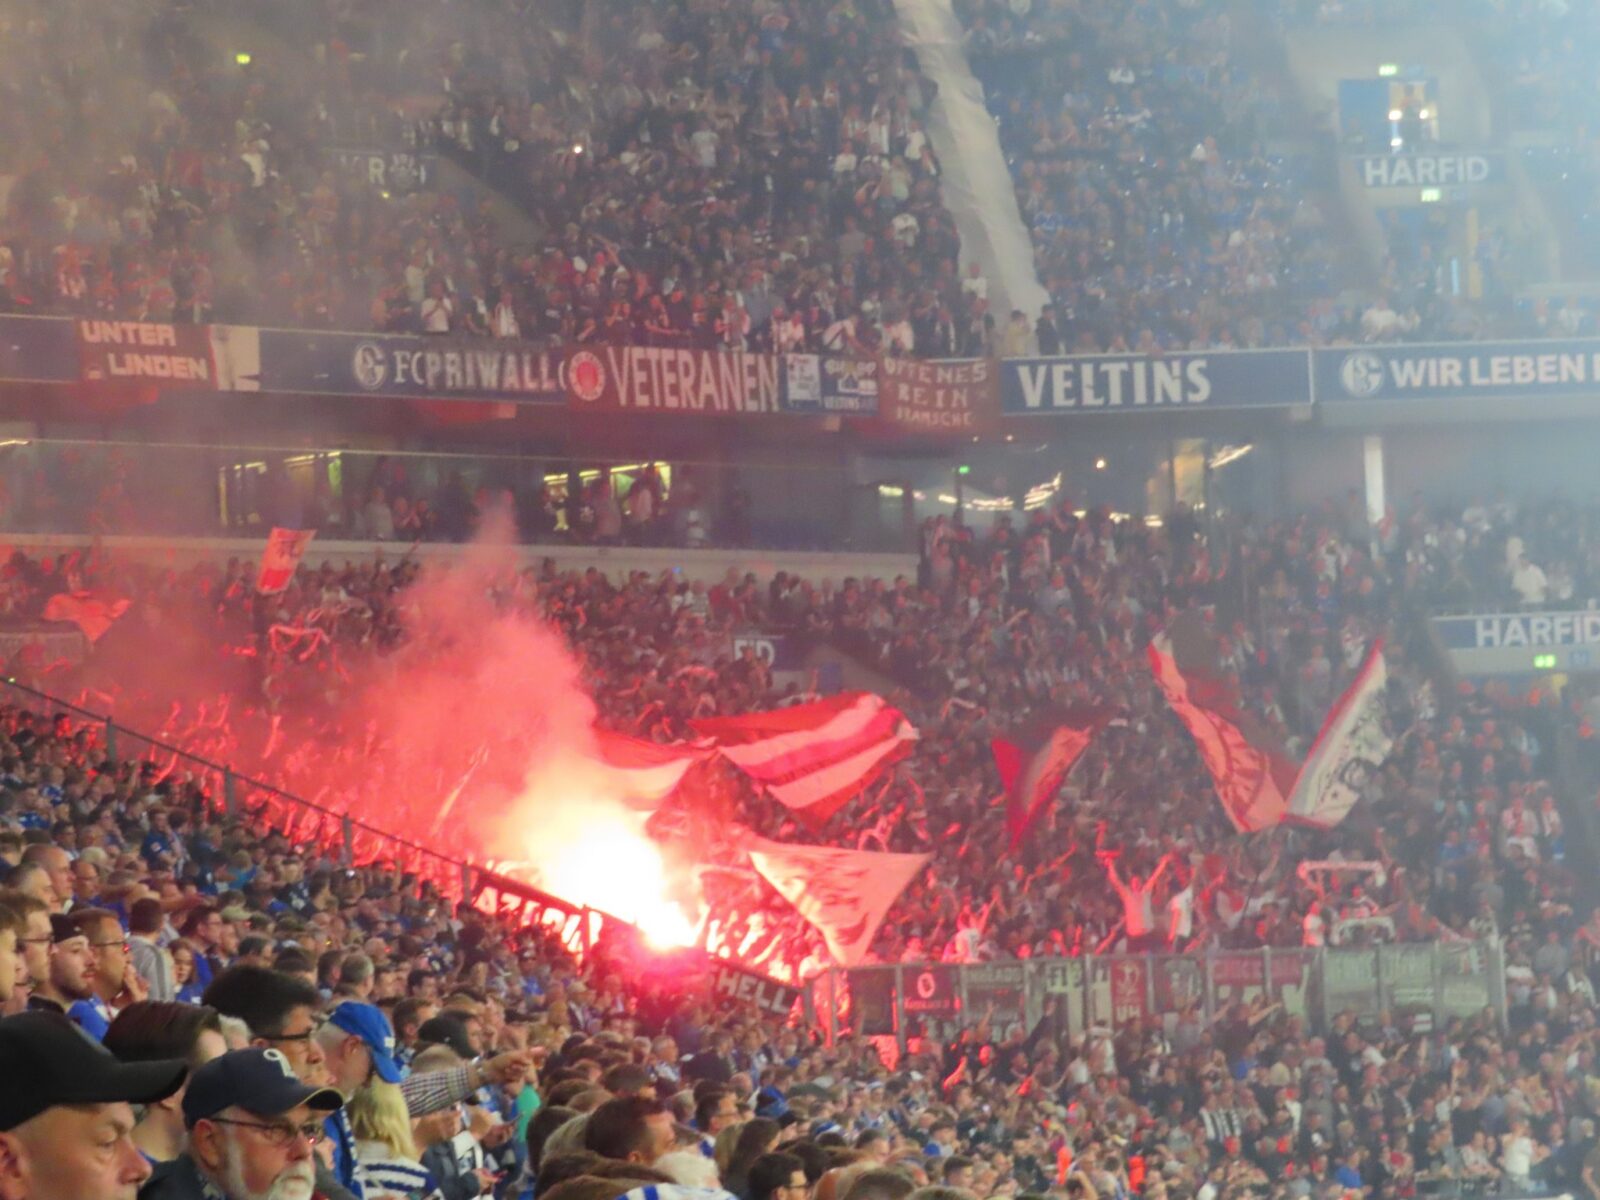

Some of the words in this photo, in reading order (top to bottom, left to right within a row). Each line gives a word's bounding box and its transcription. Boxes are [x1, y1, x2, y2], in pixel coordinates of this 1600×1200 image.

[1364, 156, 1490, 186] HARFID
[81, 320, 176, 346] UNTER
[107, 352, 208, 380] LINDEN
[424, 351, 556, 392] PRIWALL
[607, 346, 780, 413] VETERANEN
[1016, 359, 1212, 408] VELTINS
[1389, 358, 1464, 388] WIR
[1469, 353, 1586, 387] LEBEN
[1475, 615, 1600, 648] HARFID
[716, 967, 791, 1015] HELL
